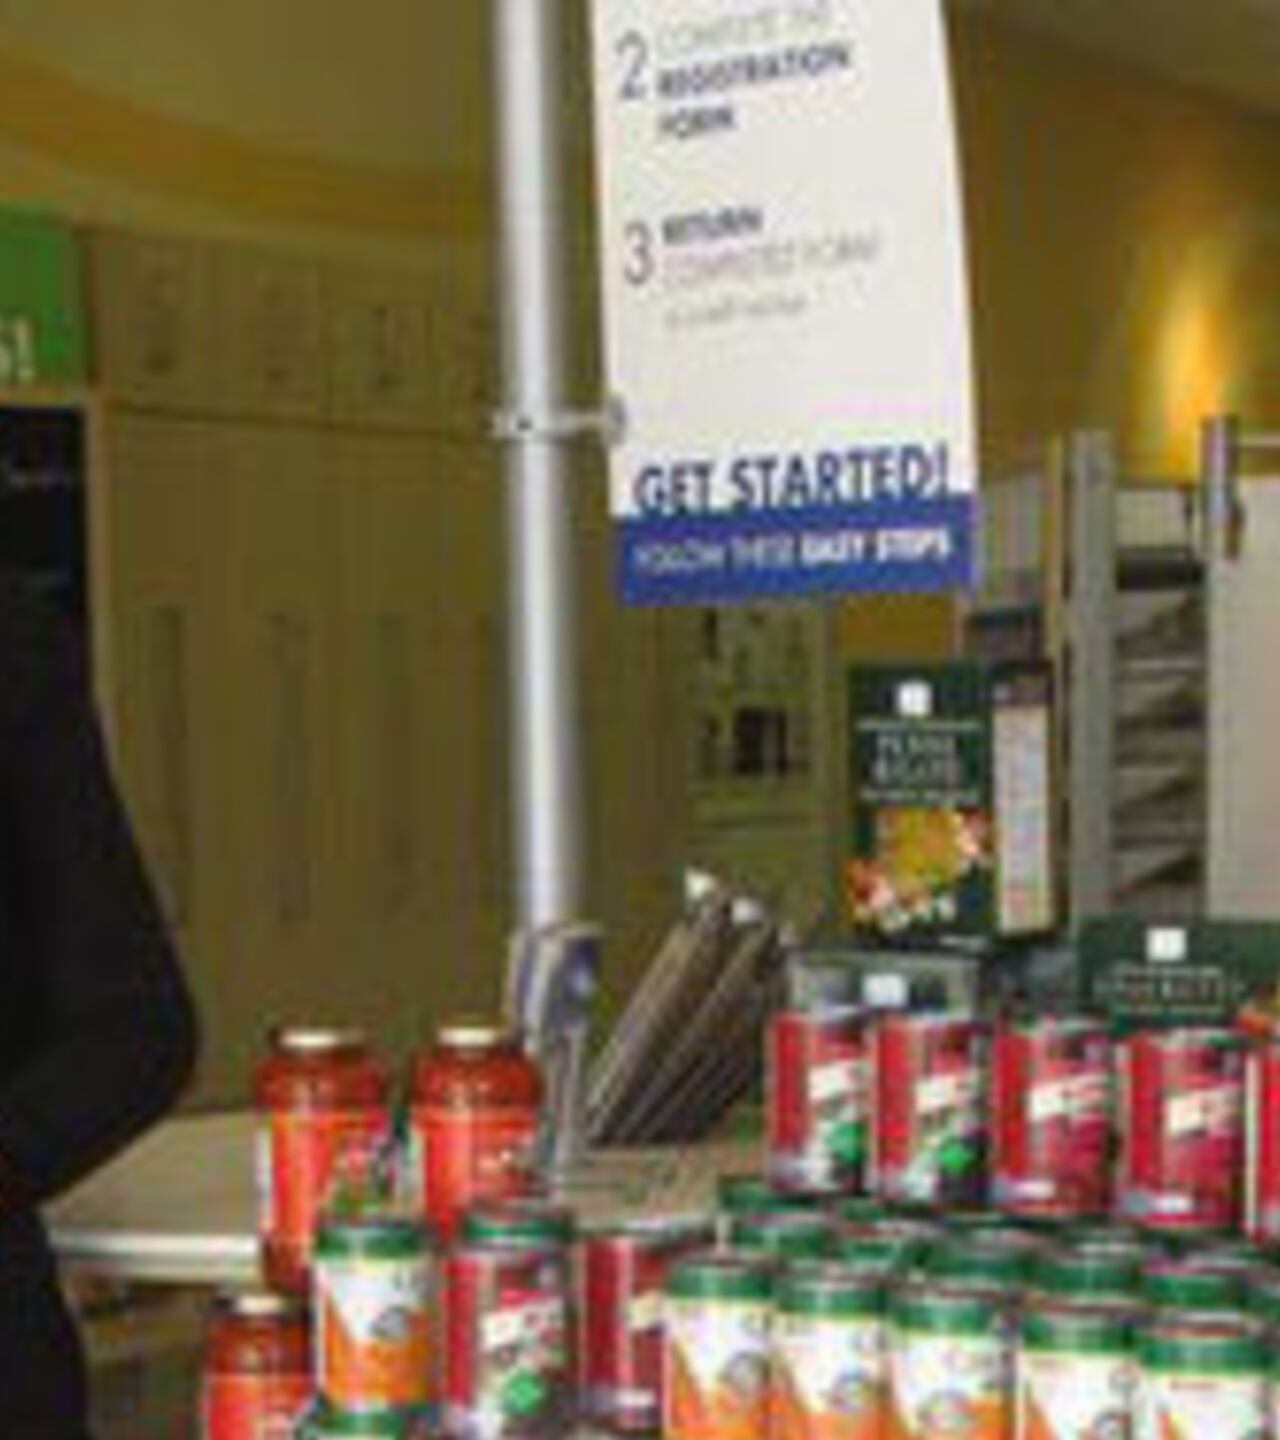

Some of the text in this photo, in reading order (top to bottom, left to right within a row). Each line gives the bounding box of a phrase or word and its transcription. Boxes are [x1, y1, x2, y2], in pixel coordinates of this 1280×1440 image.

[616, 28, 649, 100] 2
[657, 42, 853, 99] REGISTRATION
[622, 220, 656, 287] 3
[632, 440, 950, 516] GET STARTED!
